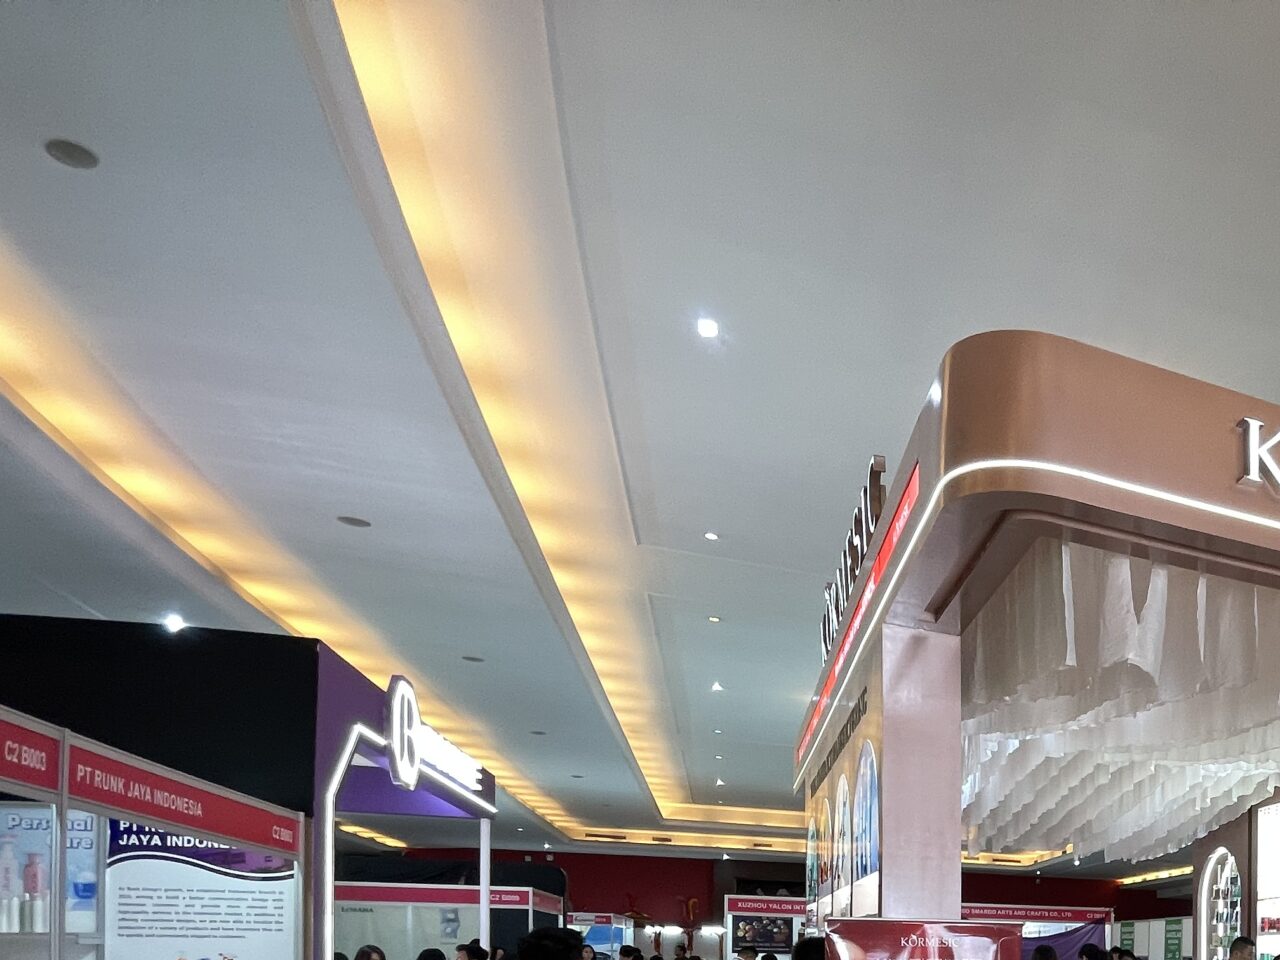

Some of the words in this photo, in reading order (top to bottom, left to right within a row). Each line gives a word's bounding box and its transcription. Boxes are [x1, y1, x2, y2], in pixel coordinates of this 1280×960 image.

[5, 740, 19, 763] C2
[22, 743, 46, 771] B003
[77, 763, 91, 785] PT
[94, 768, 125, 795] RUNK
[128, 781, 152, 803] JAYA
[154, 788, 203, 817] INDONESIA
[118, 834, 162, 846] JAYA
